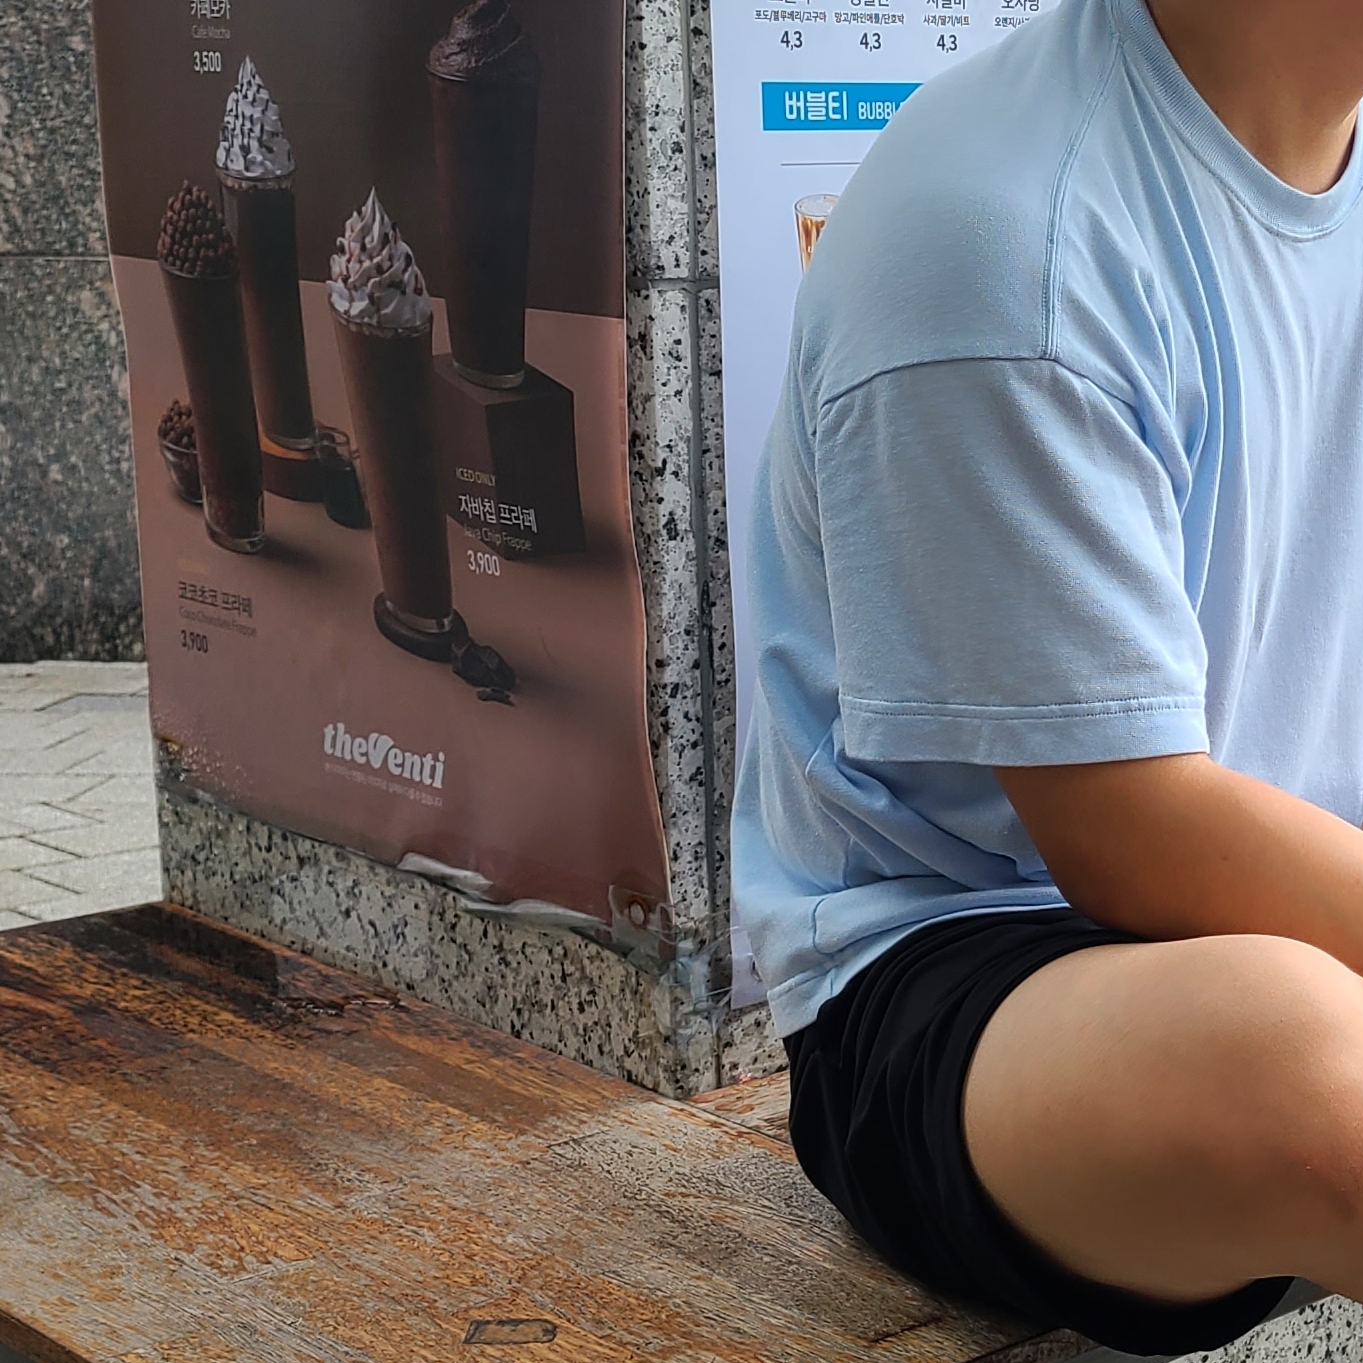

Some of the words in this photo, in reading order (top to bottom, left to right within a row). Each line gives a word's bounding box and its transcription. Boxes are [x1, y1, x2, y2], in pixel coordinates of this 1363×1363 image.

[780, 30, 803, 51] 4,3
[859, 32, 881, 52] 4,3
[936, 34, 958, 53] 4,3
[193, 51, 222, 75] 3,500
[784, 90, 848, 121] 버블티
[455, 467, 474, 482] ICED
[475, 471, 496, 486] ONLY
[458, 494, 497, 524] 자바칩
[498, 503, 538, 533] 프라페
[467, 549, 500, 576] 3,900
[179, 581, 219, 608] 코코초코
[181, 629, 209, 653] 3,900
